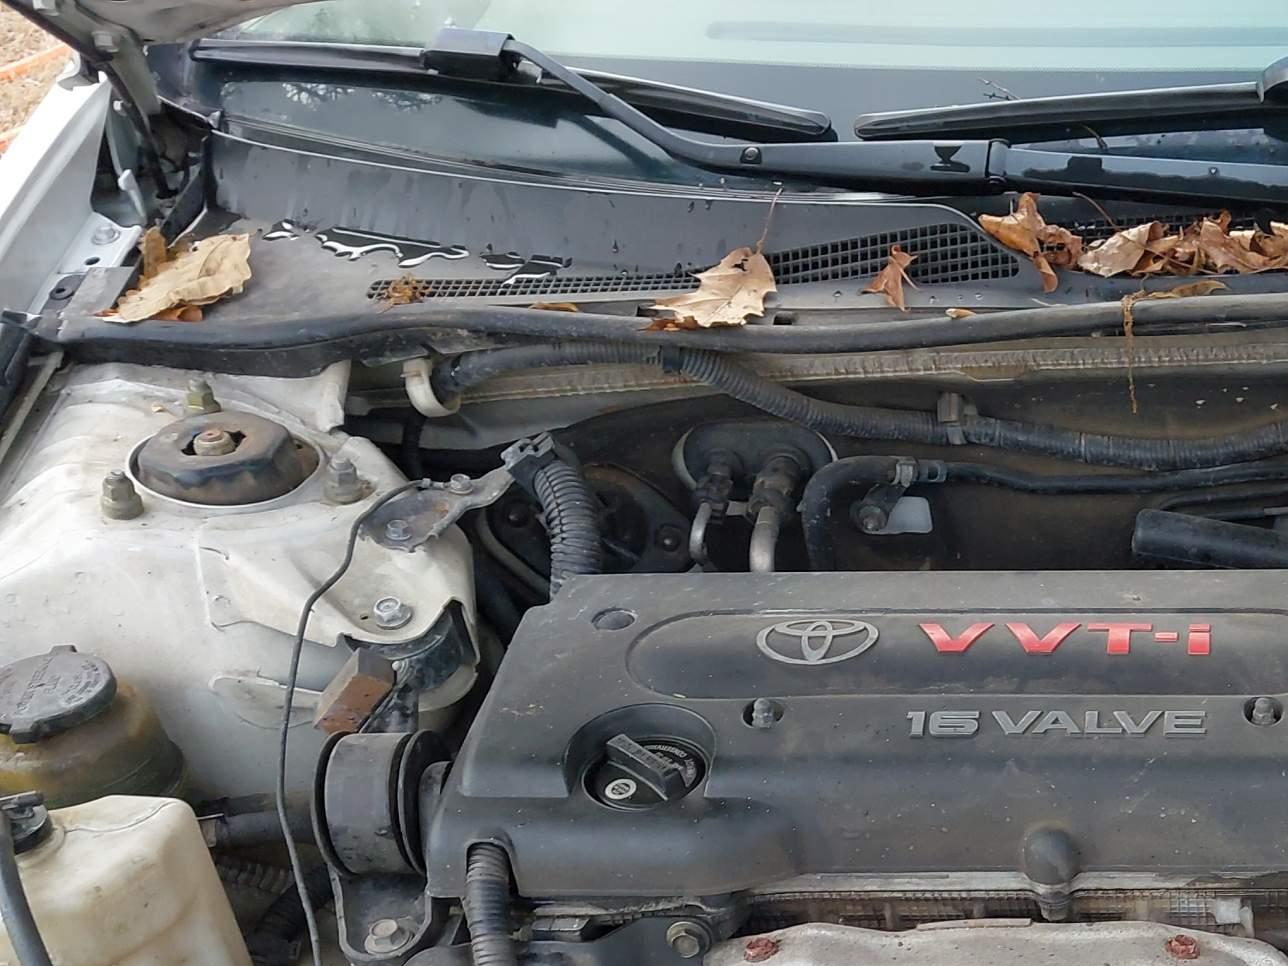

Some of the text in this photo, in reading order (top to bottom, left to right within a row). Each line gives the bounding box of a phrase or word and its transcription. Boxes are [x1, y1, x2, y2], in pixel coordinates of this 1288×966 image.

[918, 622, 1211, 656] VVT-i
[906, 710, 1208, 738] 16 VALVE
